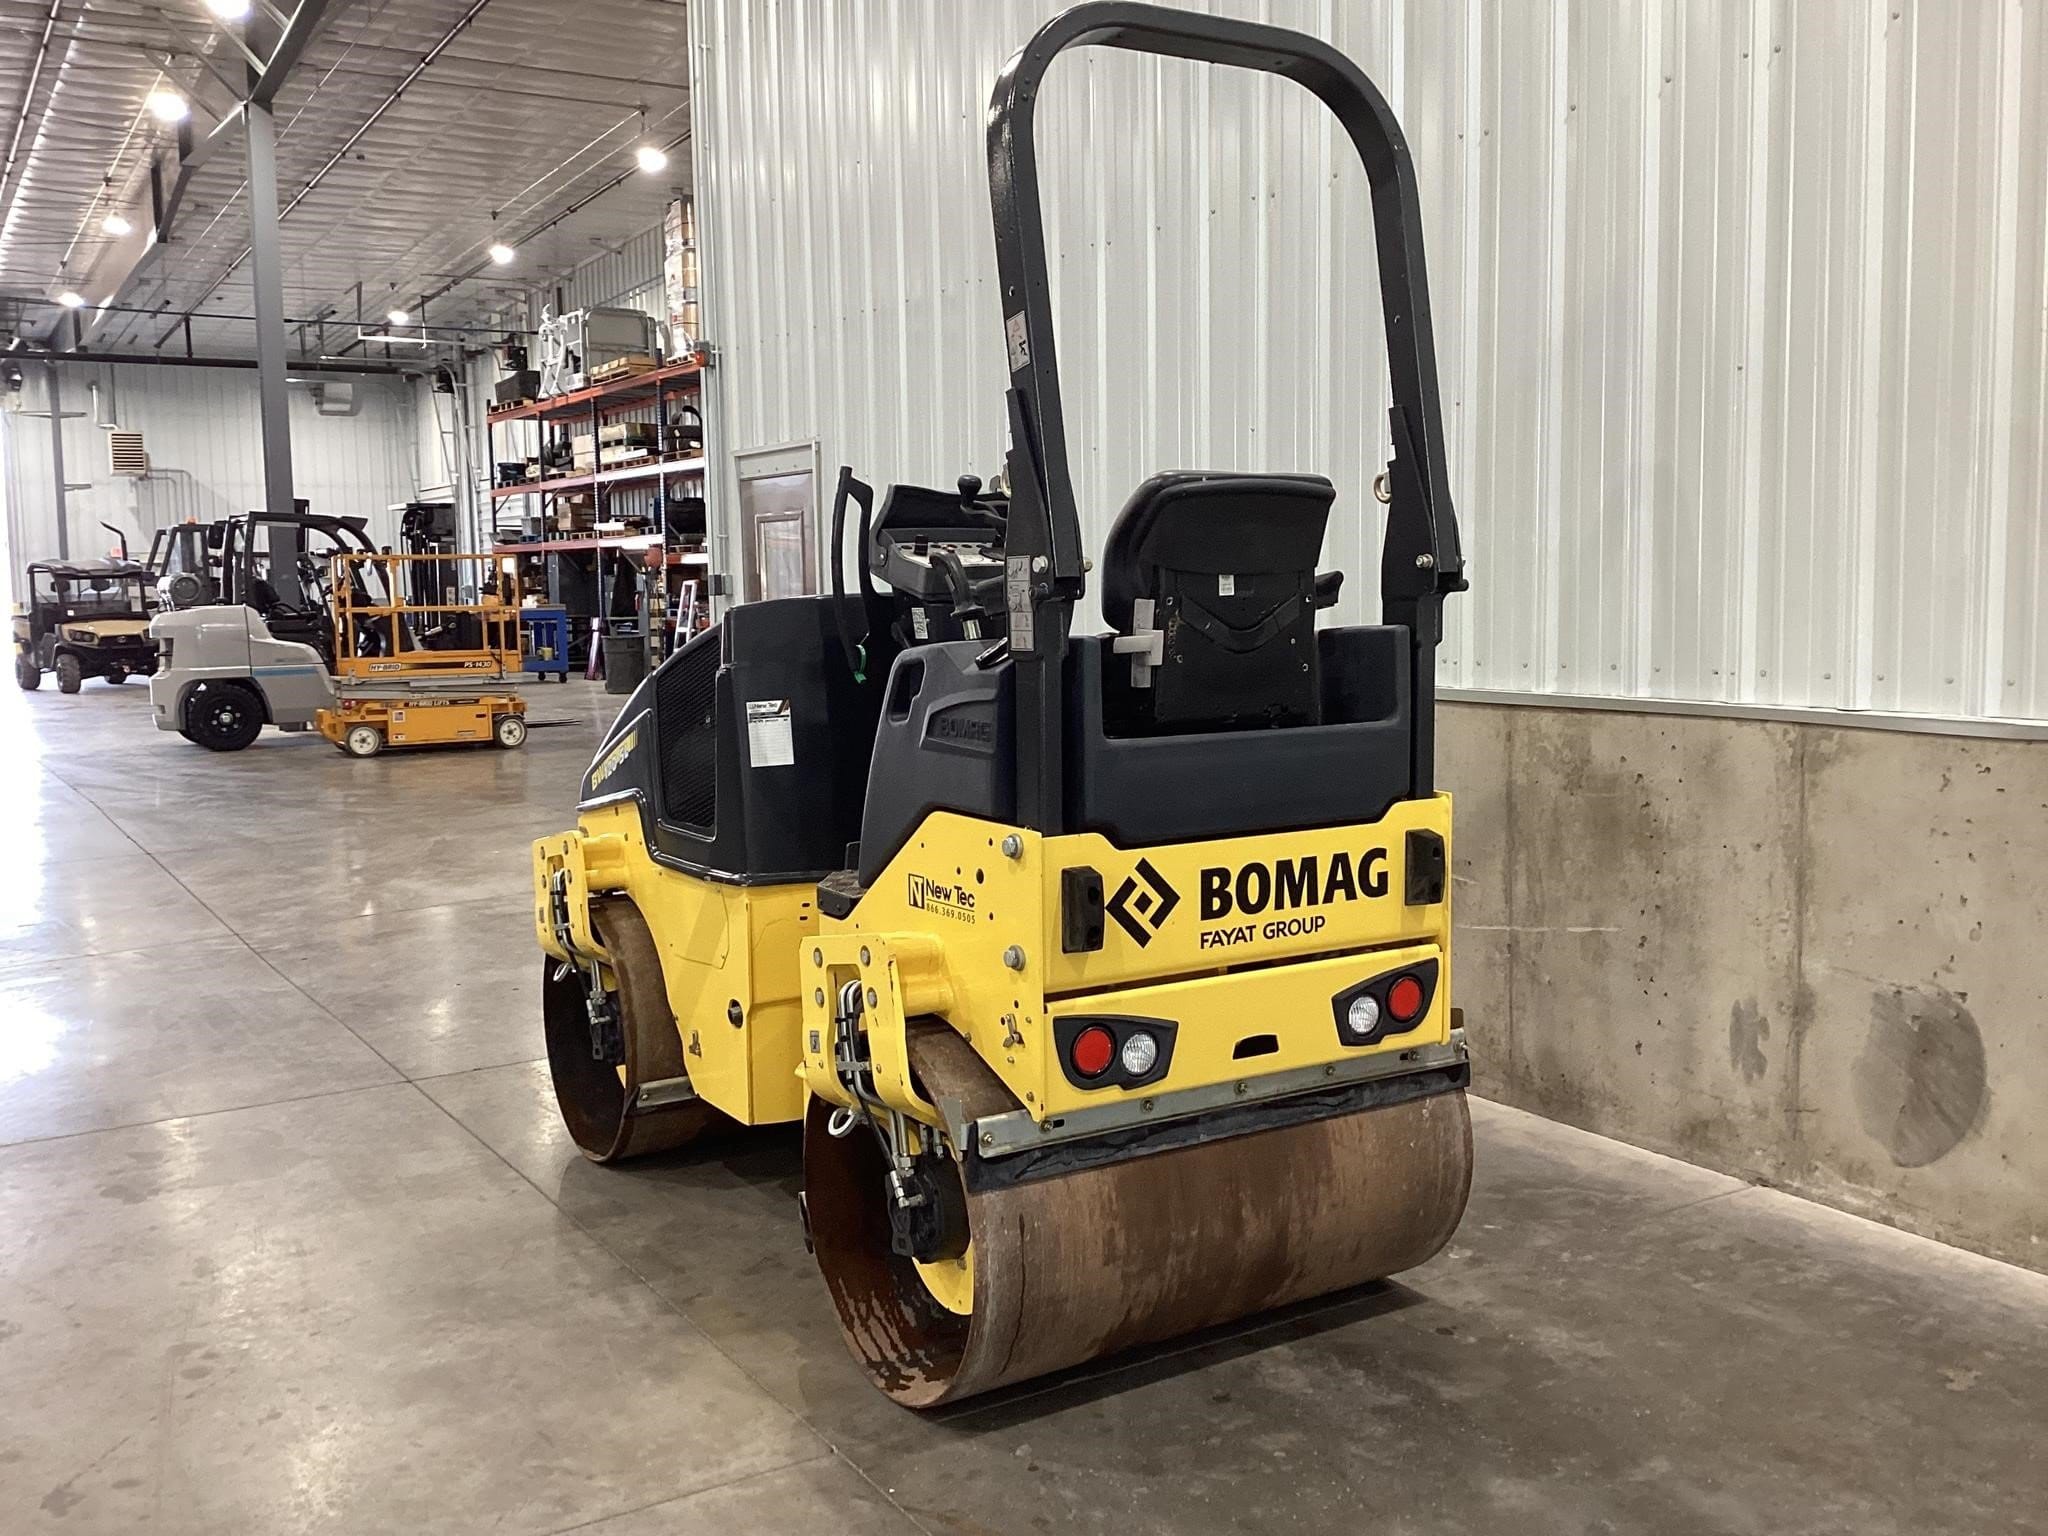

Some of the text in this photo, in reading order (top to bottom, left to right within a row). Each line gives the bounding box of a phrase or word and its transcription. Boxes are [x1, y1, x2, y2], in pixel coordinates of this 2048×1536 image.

[925, 878, 952, 902] New
[954, 885, 975, 908] Tec
[1200, 847, 1389, 921] BOMAG
[926, 903, 976, 924] 866.369.0505
[1200, 915, 1326, 949] FAYAT GROUP
